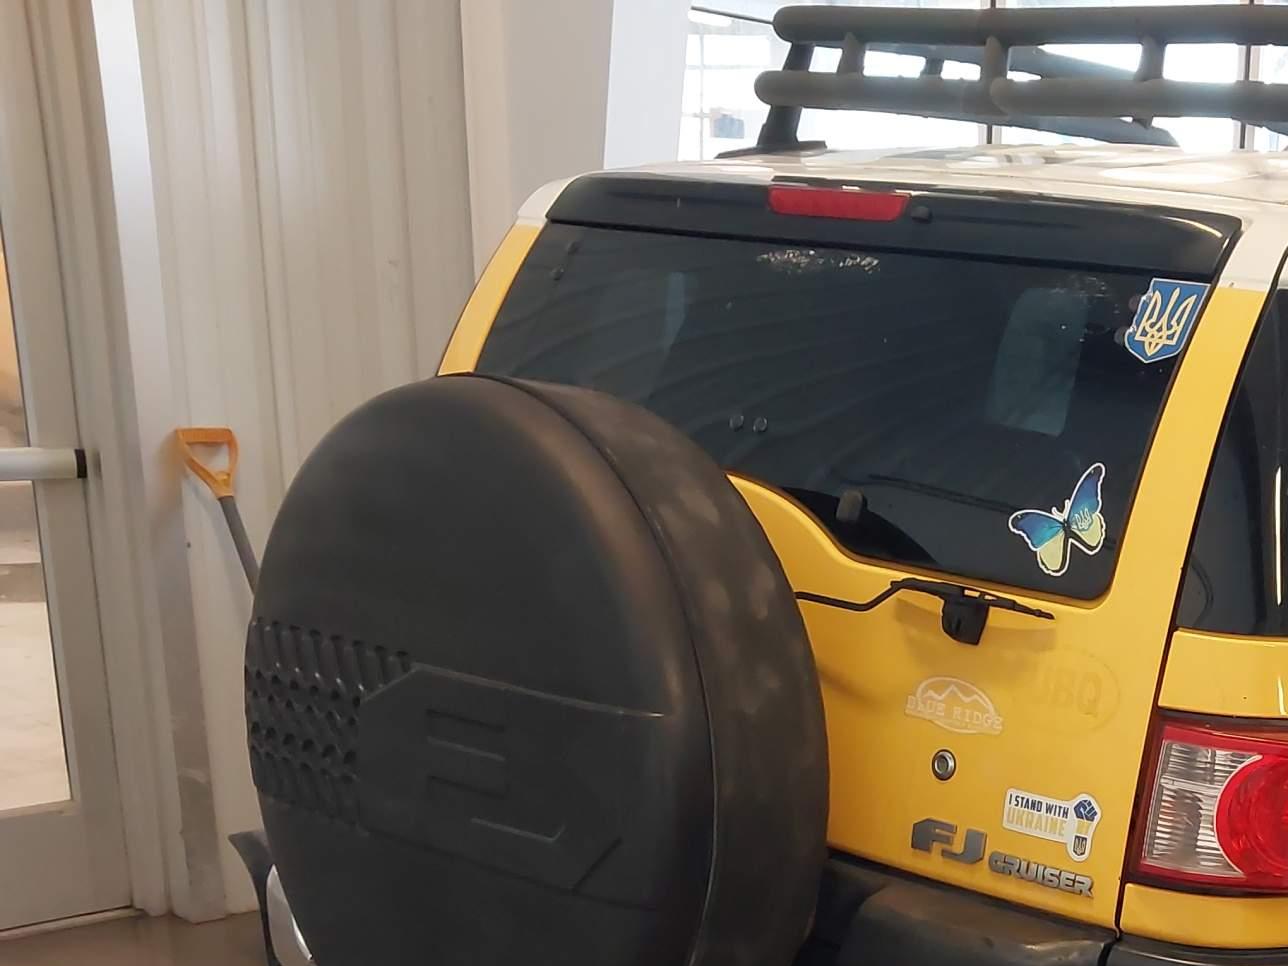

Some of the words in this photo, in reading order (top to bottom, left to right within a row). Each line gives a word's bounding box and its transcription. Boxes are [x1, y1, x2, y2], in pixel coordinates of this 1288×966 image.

[953, 706, 1002, 729] RIDGE
[1008, 793, 1013, 805] I
[1014, 795, 1043, 812] STAND
[1045, 802, 1070, 819] WITH
[1006, 807, 1067, 837] UKRAINE
[911, 818, 987, 864] FJ
[988, 851, 1094, 898] CRUISER
